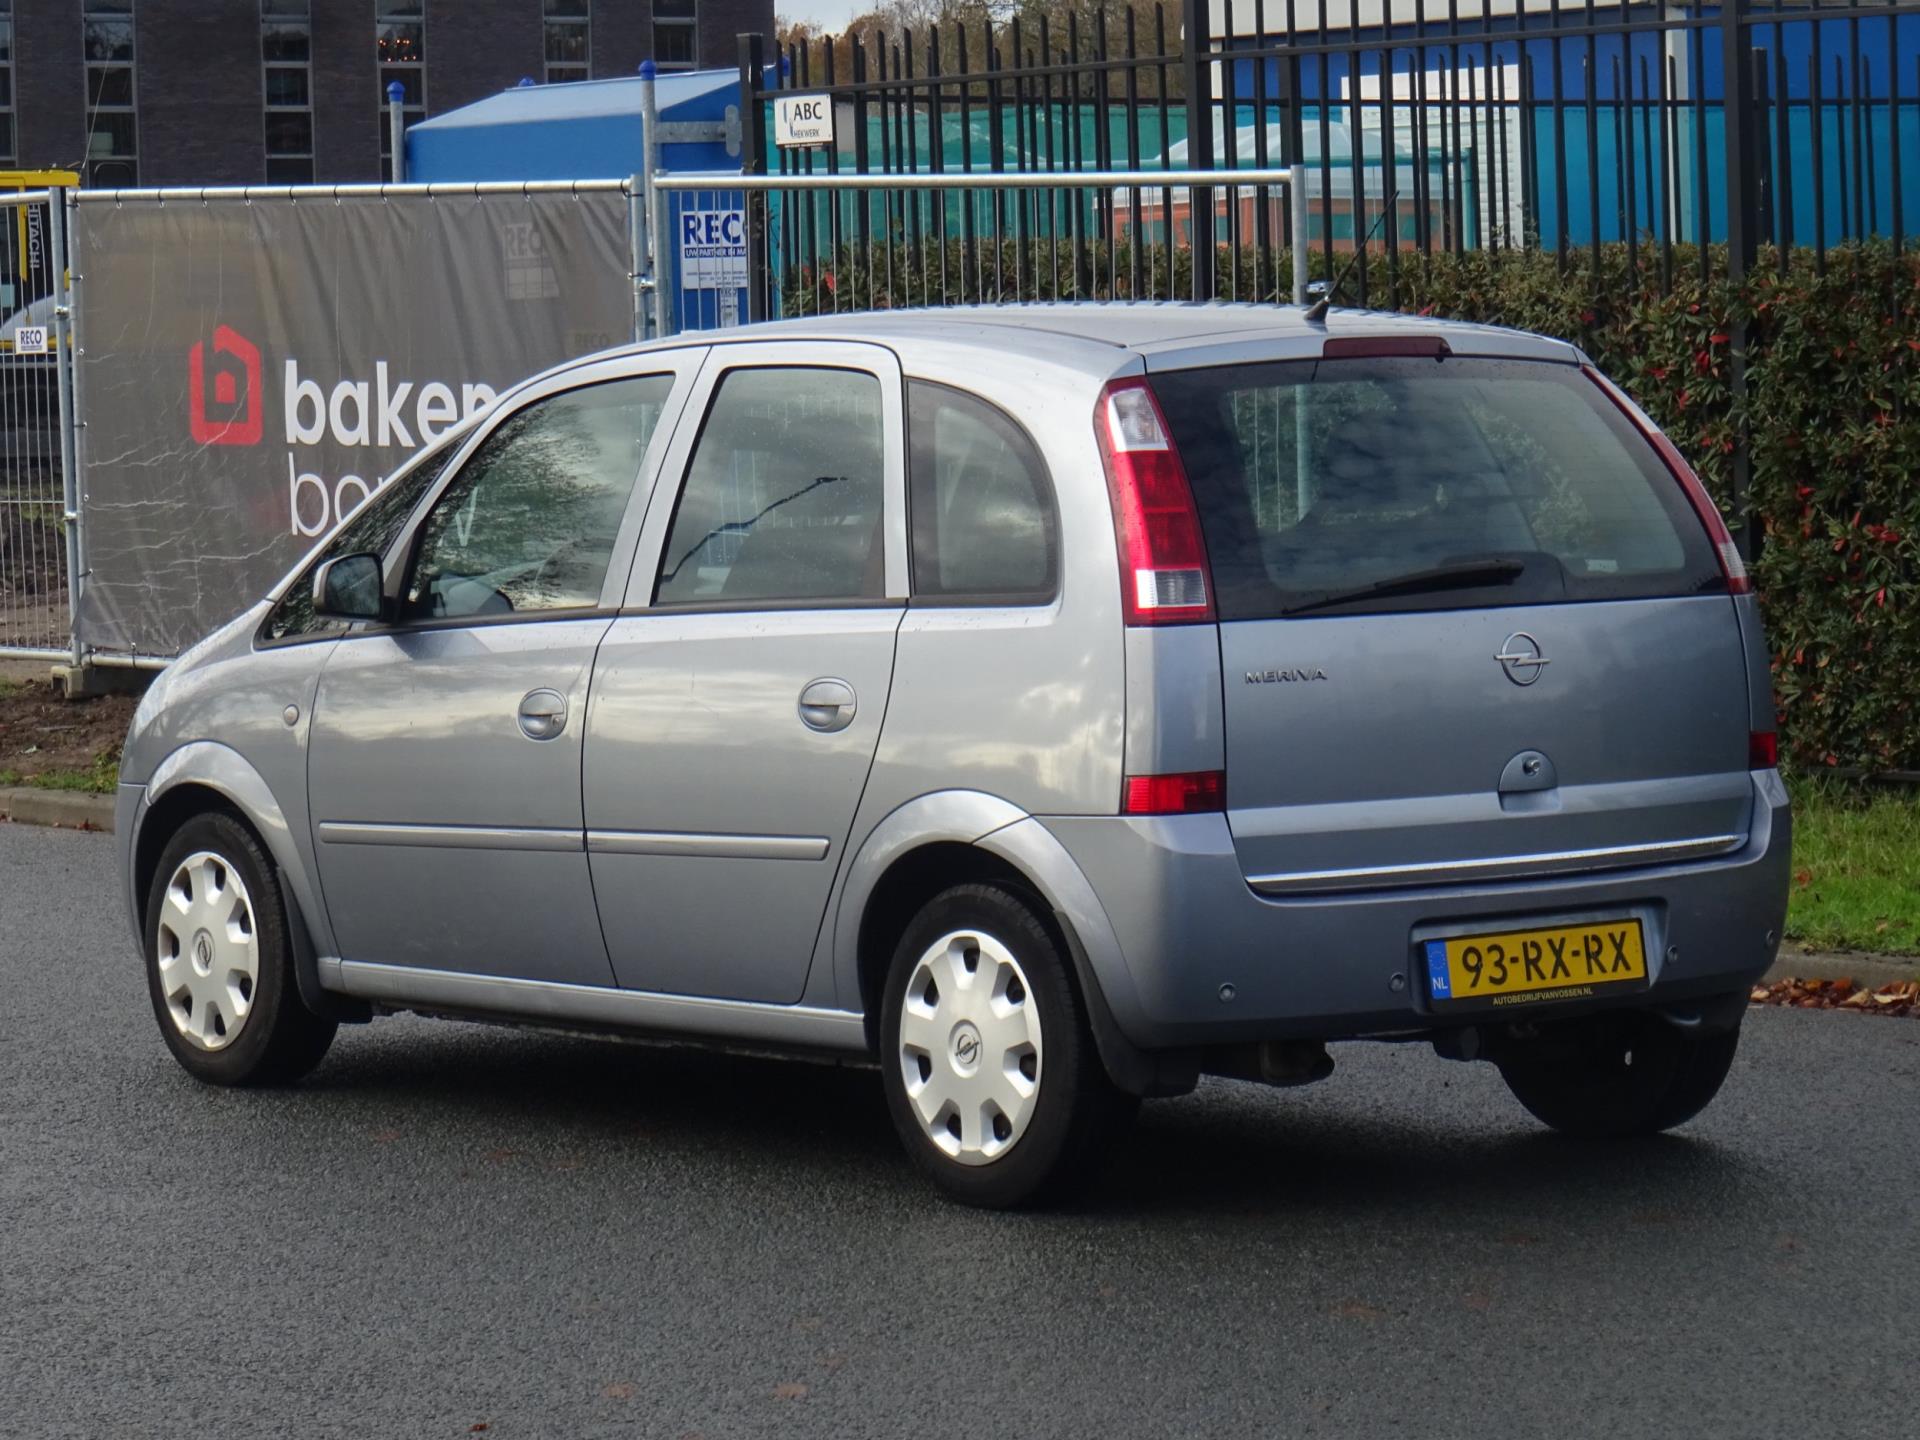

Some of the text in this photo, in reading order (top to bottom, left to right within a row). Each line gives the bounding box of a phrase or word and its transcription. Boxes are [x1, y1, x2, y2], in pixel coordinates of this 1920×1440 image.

[794, 102, 822, 120] ABC
[28, 203, 40, 268] HITACHI
[683, 213, 746, 244] REC
[20, 330, 42, 345] RECO
[1244, 668, 1328, 684] MERIVA
[1462, 931, 1631, 988] 93-RX-RX
[1432, 976, 1448, 990] NL
[1493, 988, 1593, 1007] AUTOBEDRIJFVANVOSSEN.NL
